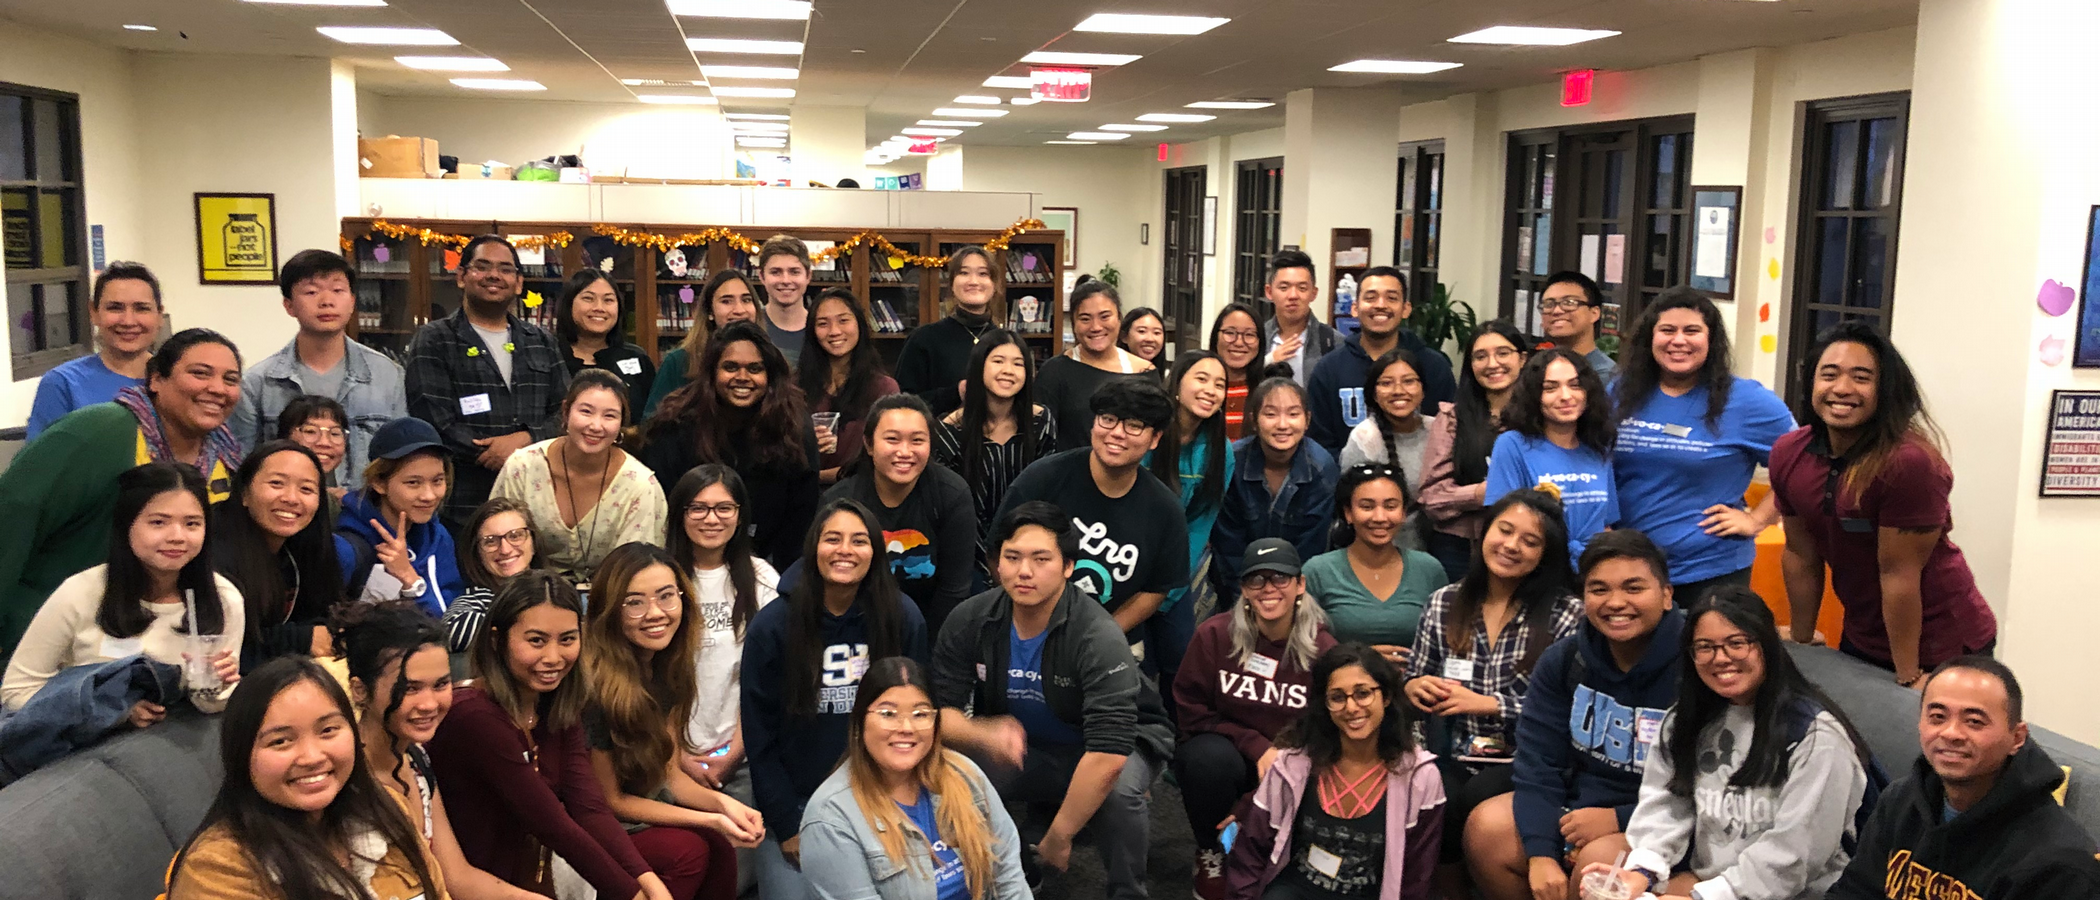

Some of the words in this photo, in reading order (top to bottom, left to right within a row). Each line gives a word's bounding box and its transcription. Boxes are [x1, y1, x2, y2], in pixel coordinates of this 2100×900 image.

[228, 253, 264, 262] people
[2058, 398, 2075, 414] IN
[1219, 669, 1308, 709] VANS
